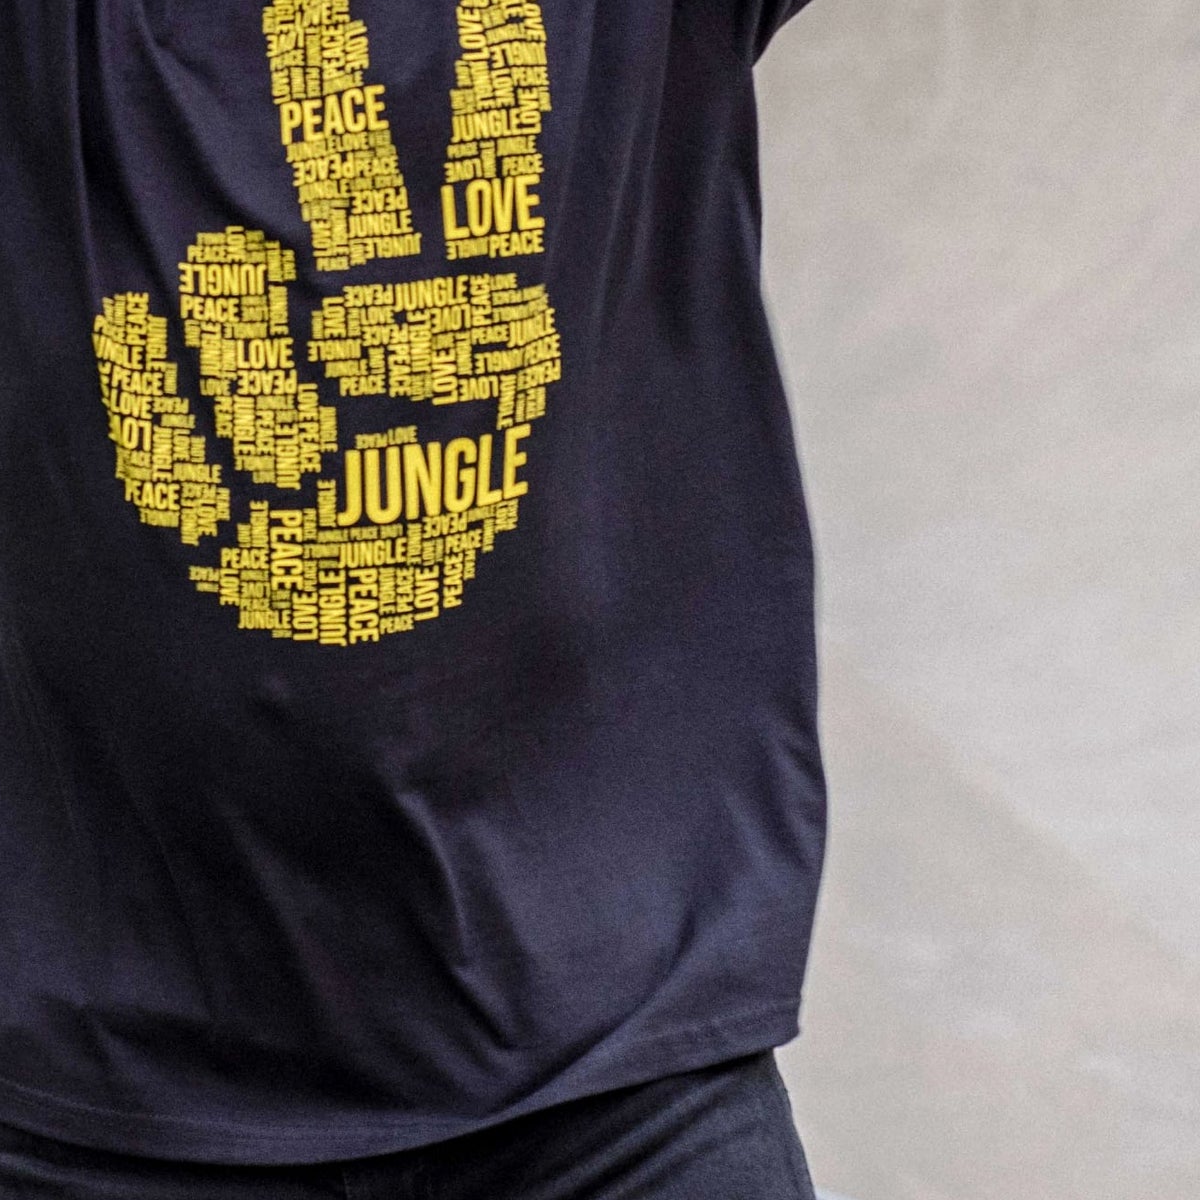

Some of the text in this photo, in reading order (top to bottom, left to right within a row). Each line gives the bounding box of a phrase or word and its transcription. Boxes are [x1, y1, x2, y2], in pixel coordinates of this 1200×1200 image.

[456, 6, 490, 61] LOVE
[280, 84, 390, 146] PEACE
[451, 107, 523, 143] JUNGLE
[292, 152, 355, 187] PEACE
[350, 186, 409, 215] PEACE
[440, 174, 546, 241] LOVE
[348, 209, 414, 238] JUNGLE
[489, 229, 545, 259] PEACE
[177, 262, 267, 296] JUNGLE
[393, 275, 469, 312] JUNGLE
[180, 294, 240, 323] PEACE
[322, 297, 347, 339] LOVE
[430, 304, 471, 334] LOVE
[237, 337, 295, 369] LOVE
[111, 367, 164, 397] PEACE
[236, 369, 298, 396] PEACE
[431, 348, 458, 406] LOVE
[457, 375, 499, 402] LOVE
[110, 388, 152, 419] LOVE
[274, 422, 301, 490] JUNGLE
[337, 423, 531, 526] JUNGLE
[269, 509, 303, 591] PEACE
[338, 537, 407, 569] JUNGLE
[414, 564, 440, 621] LOVE
[443, 552, 464, 609] PEACE
[292, 591, 319, 641] LOVE
[319, 569, 347, 647] JUNGLE
[348, 567, 380, 644] PEACE
